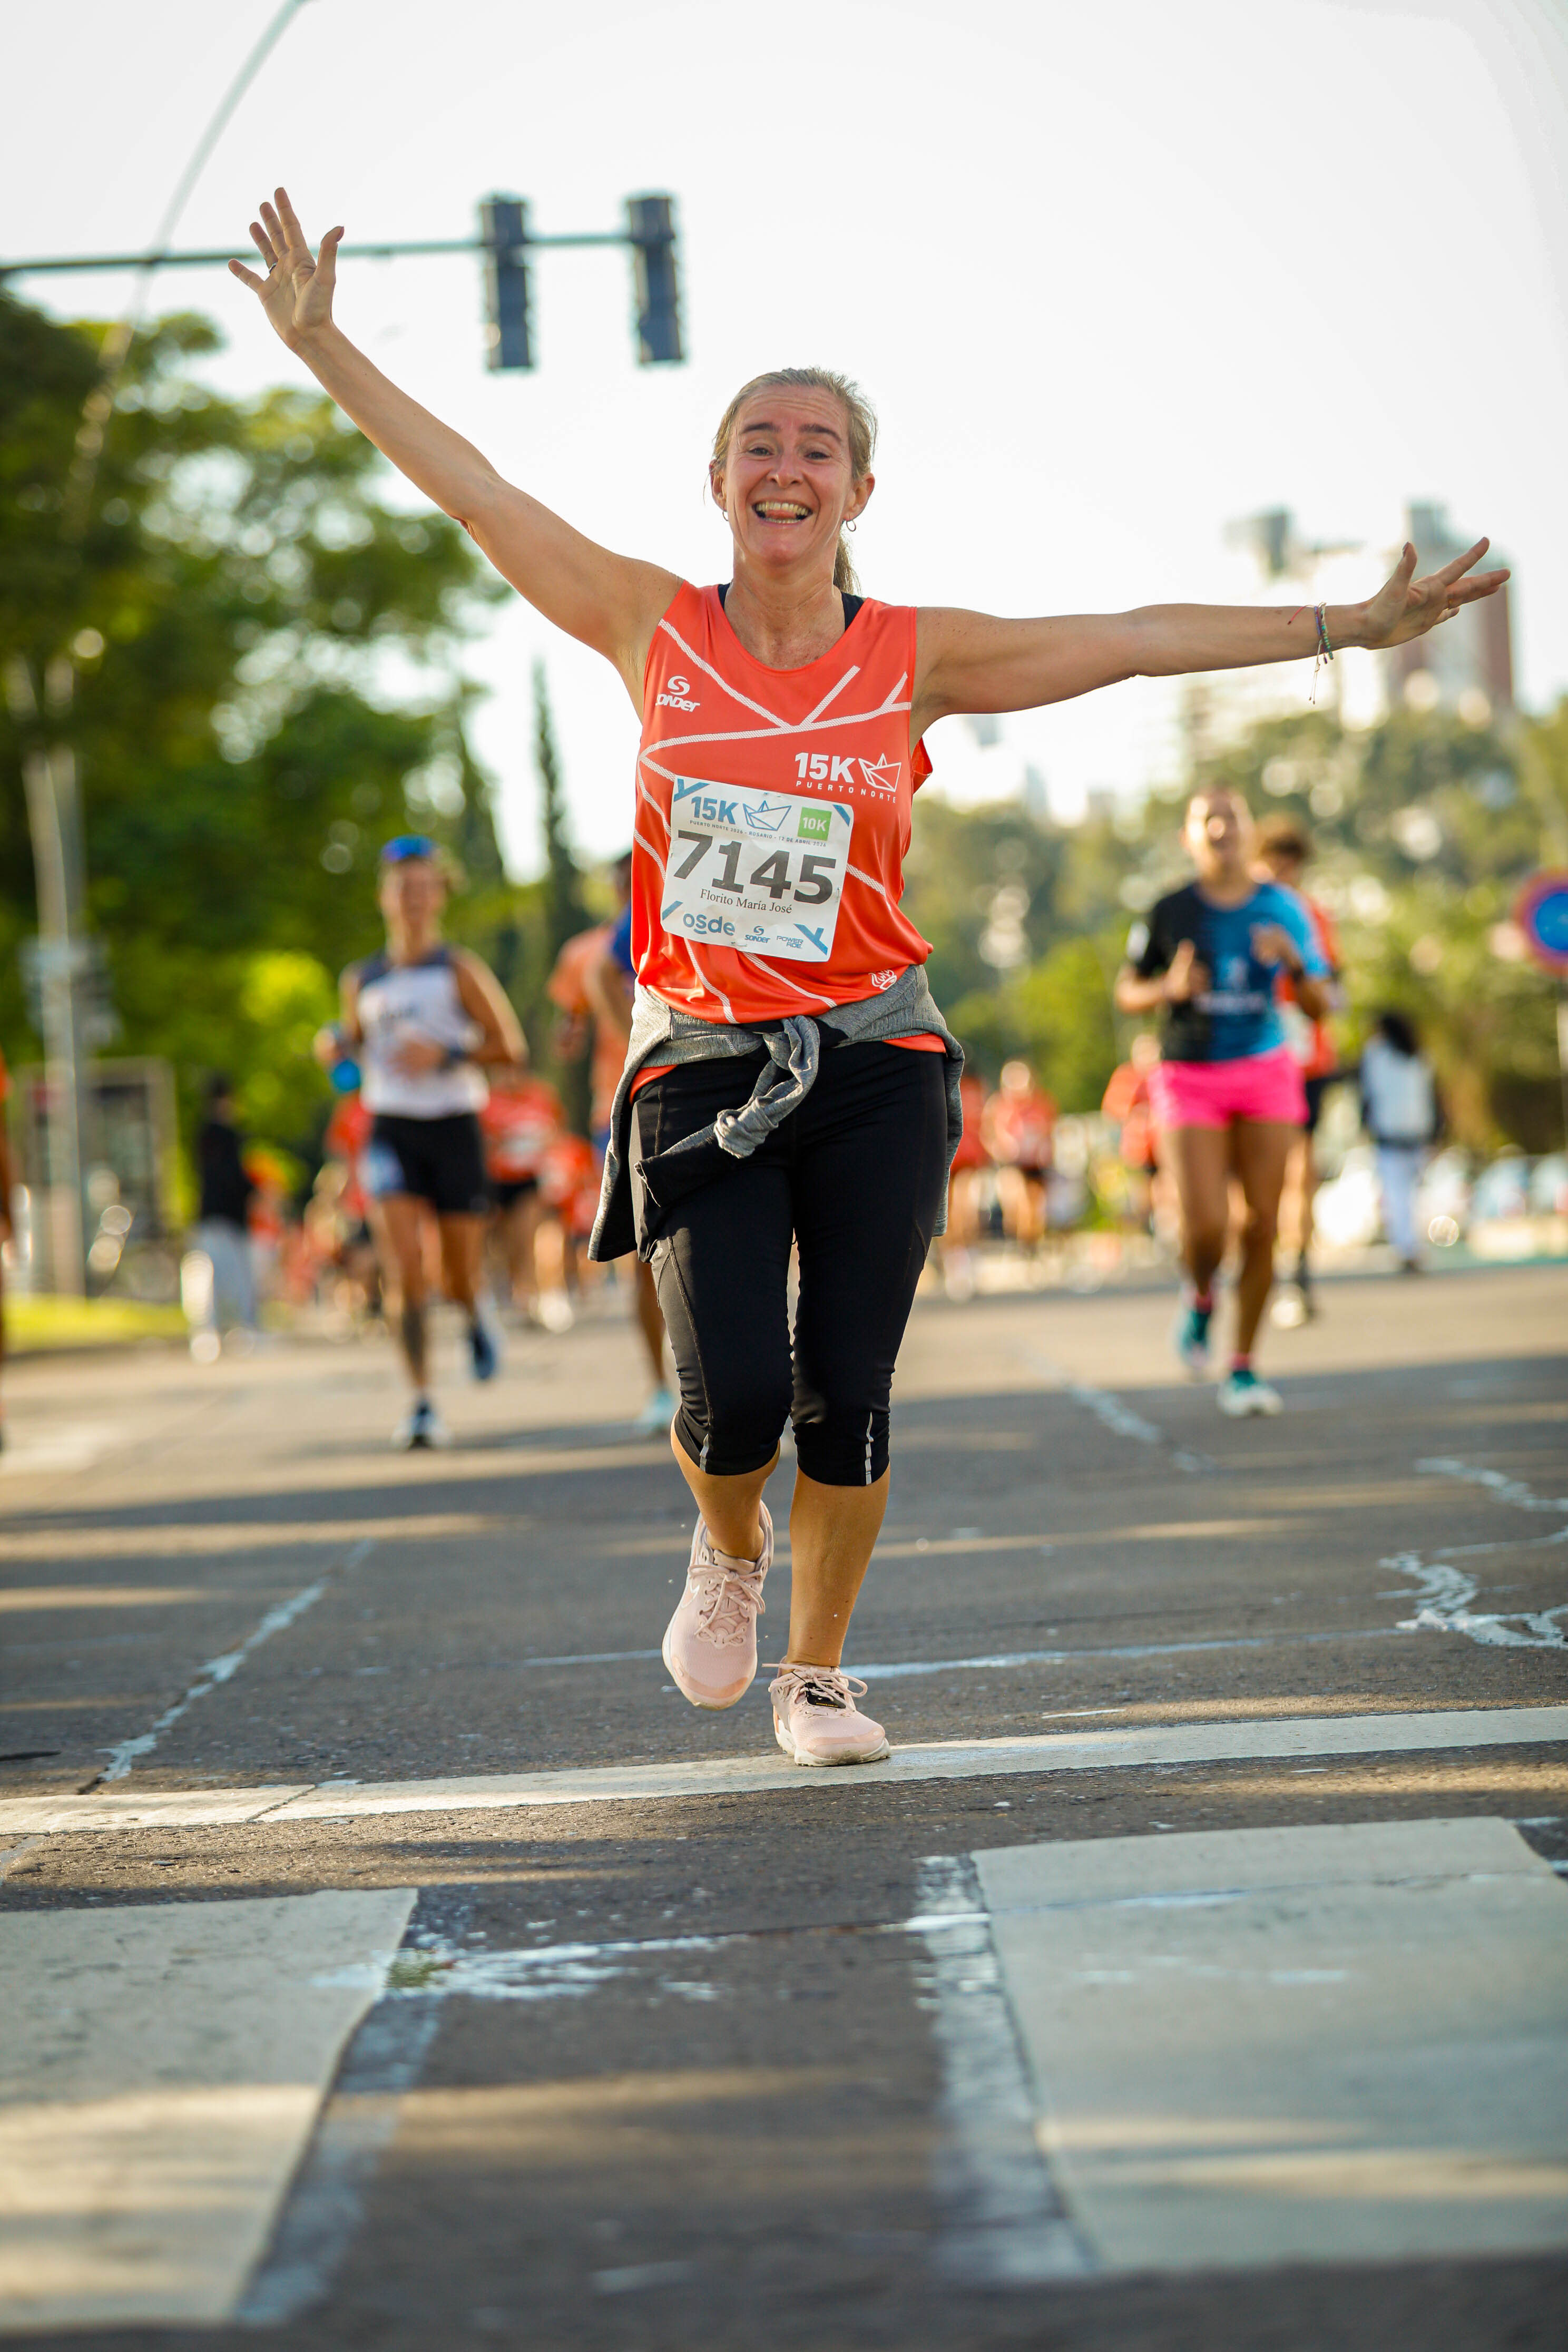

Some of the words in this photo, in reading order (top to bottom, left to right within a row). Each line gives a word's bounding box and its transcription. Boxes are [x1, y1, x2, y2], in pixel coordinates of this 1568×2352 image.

[795, 752, 856, 783] 15K
[796, 780, 854, 793] PUERTO
[860, 788, 896, 803] NORTE
[691, 796, 739, 825] 15K
[802, 817, 826, 832] 10K
[673, 829, 837, 905] 7145
[700, 888, 733, 905] Florito
[736, 897, 767, 910] María
[769, 901, 792, 914] José
[683, 913, 735, 936] osde
